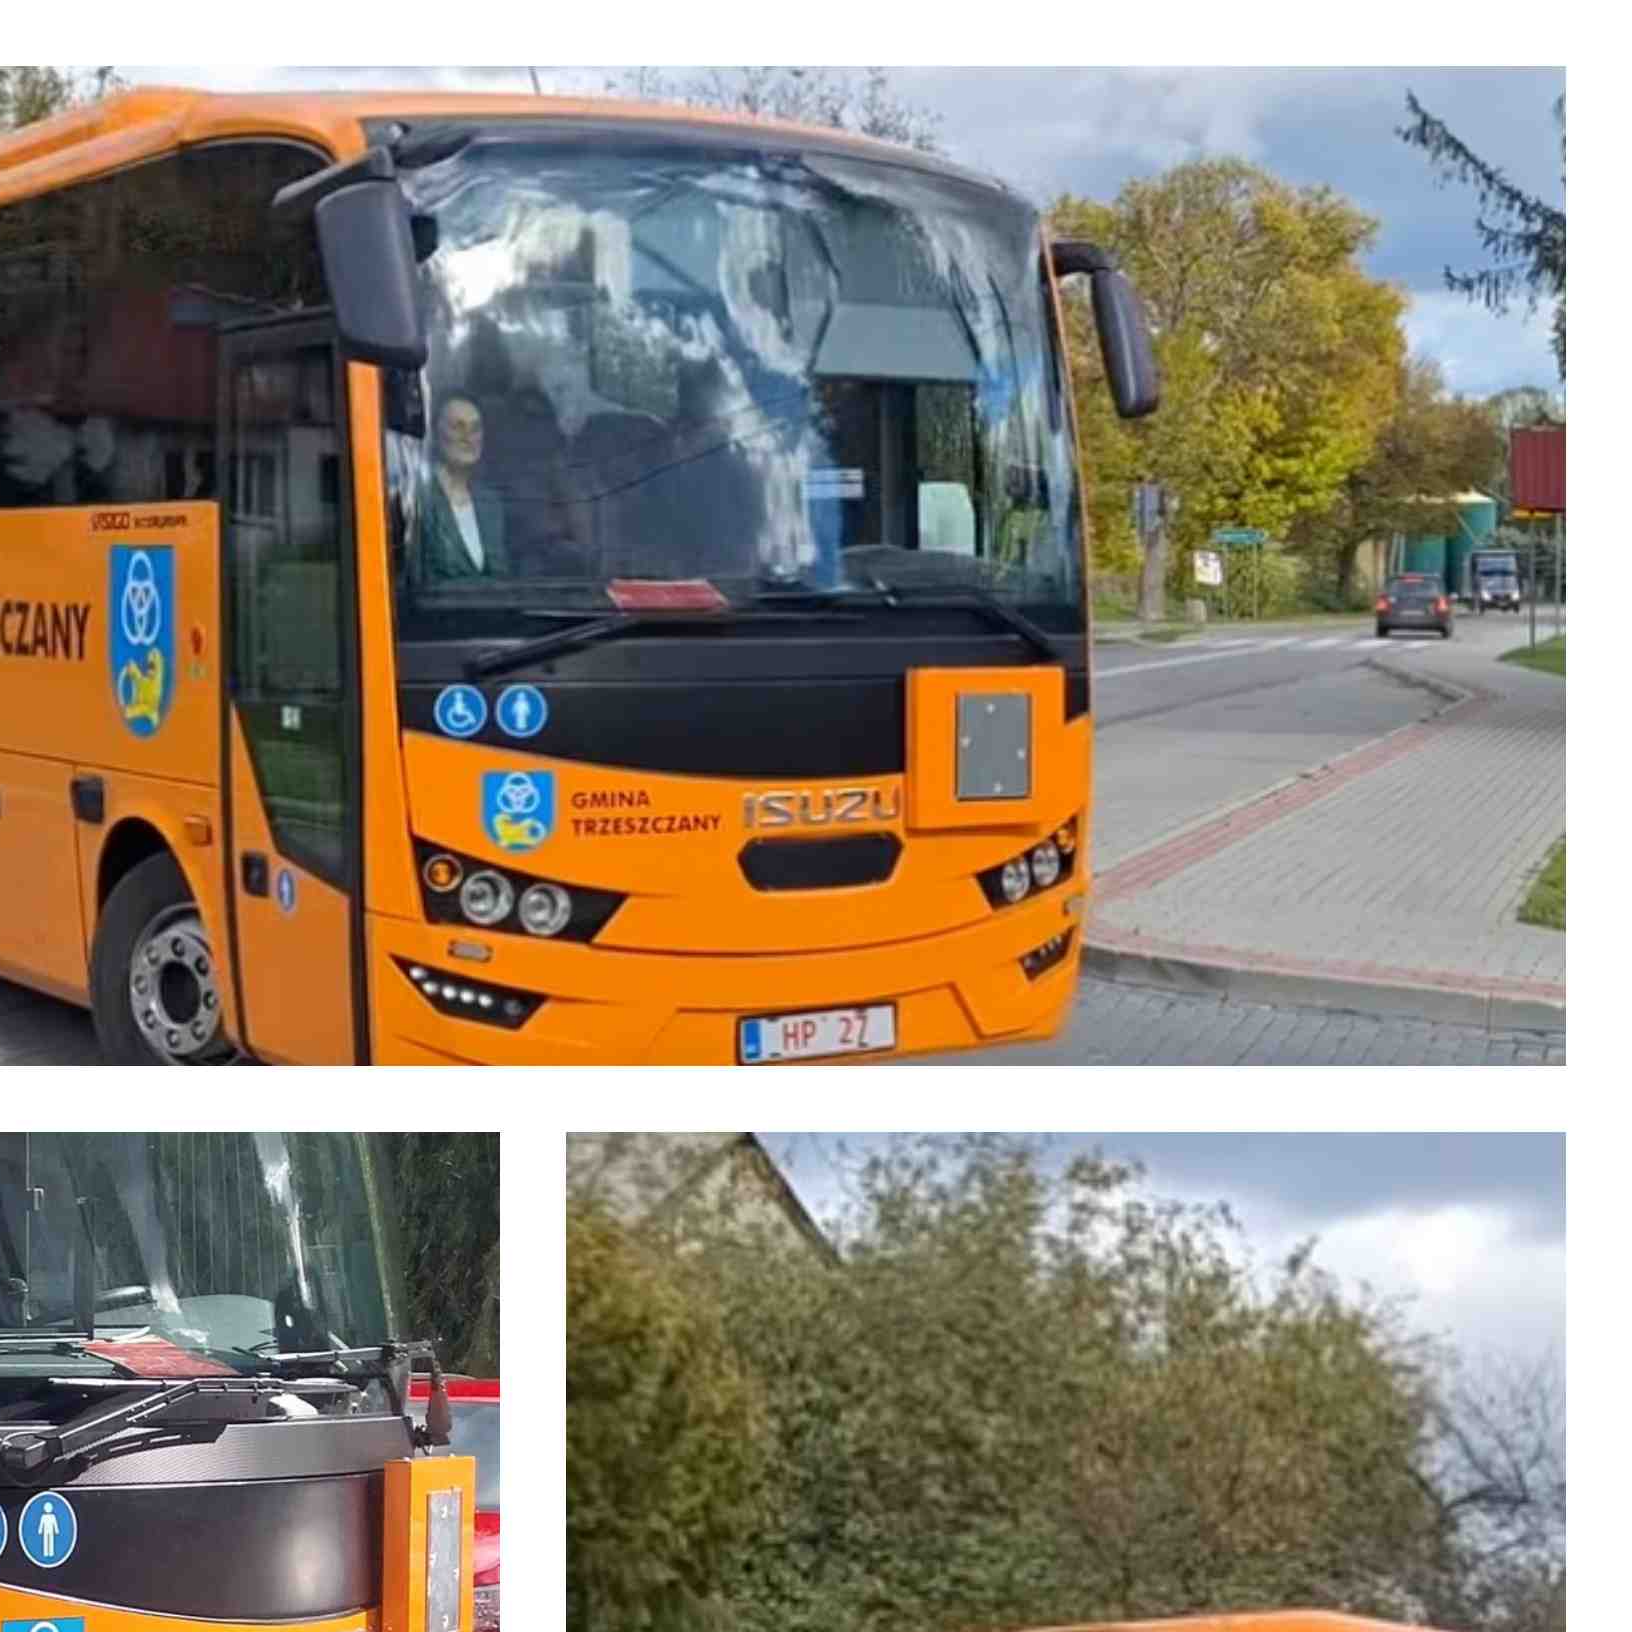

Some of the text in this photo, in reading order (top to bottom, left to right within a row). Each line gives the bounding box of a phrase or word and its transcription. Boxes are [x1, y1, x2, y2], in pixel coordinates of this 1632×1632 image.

[571, 790, 651, 810] GMINA
[742, 786, 901, 829] ISUZU
[571, 814, 721, 838] TRZESZCZANY
[782, 1020, 817, 1050] HP
